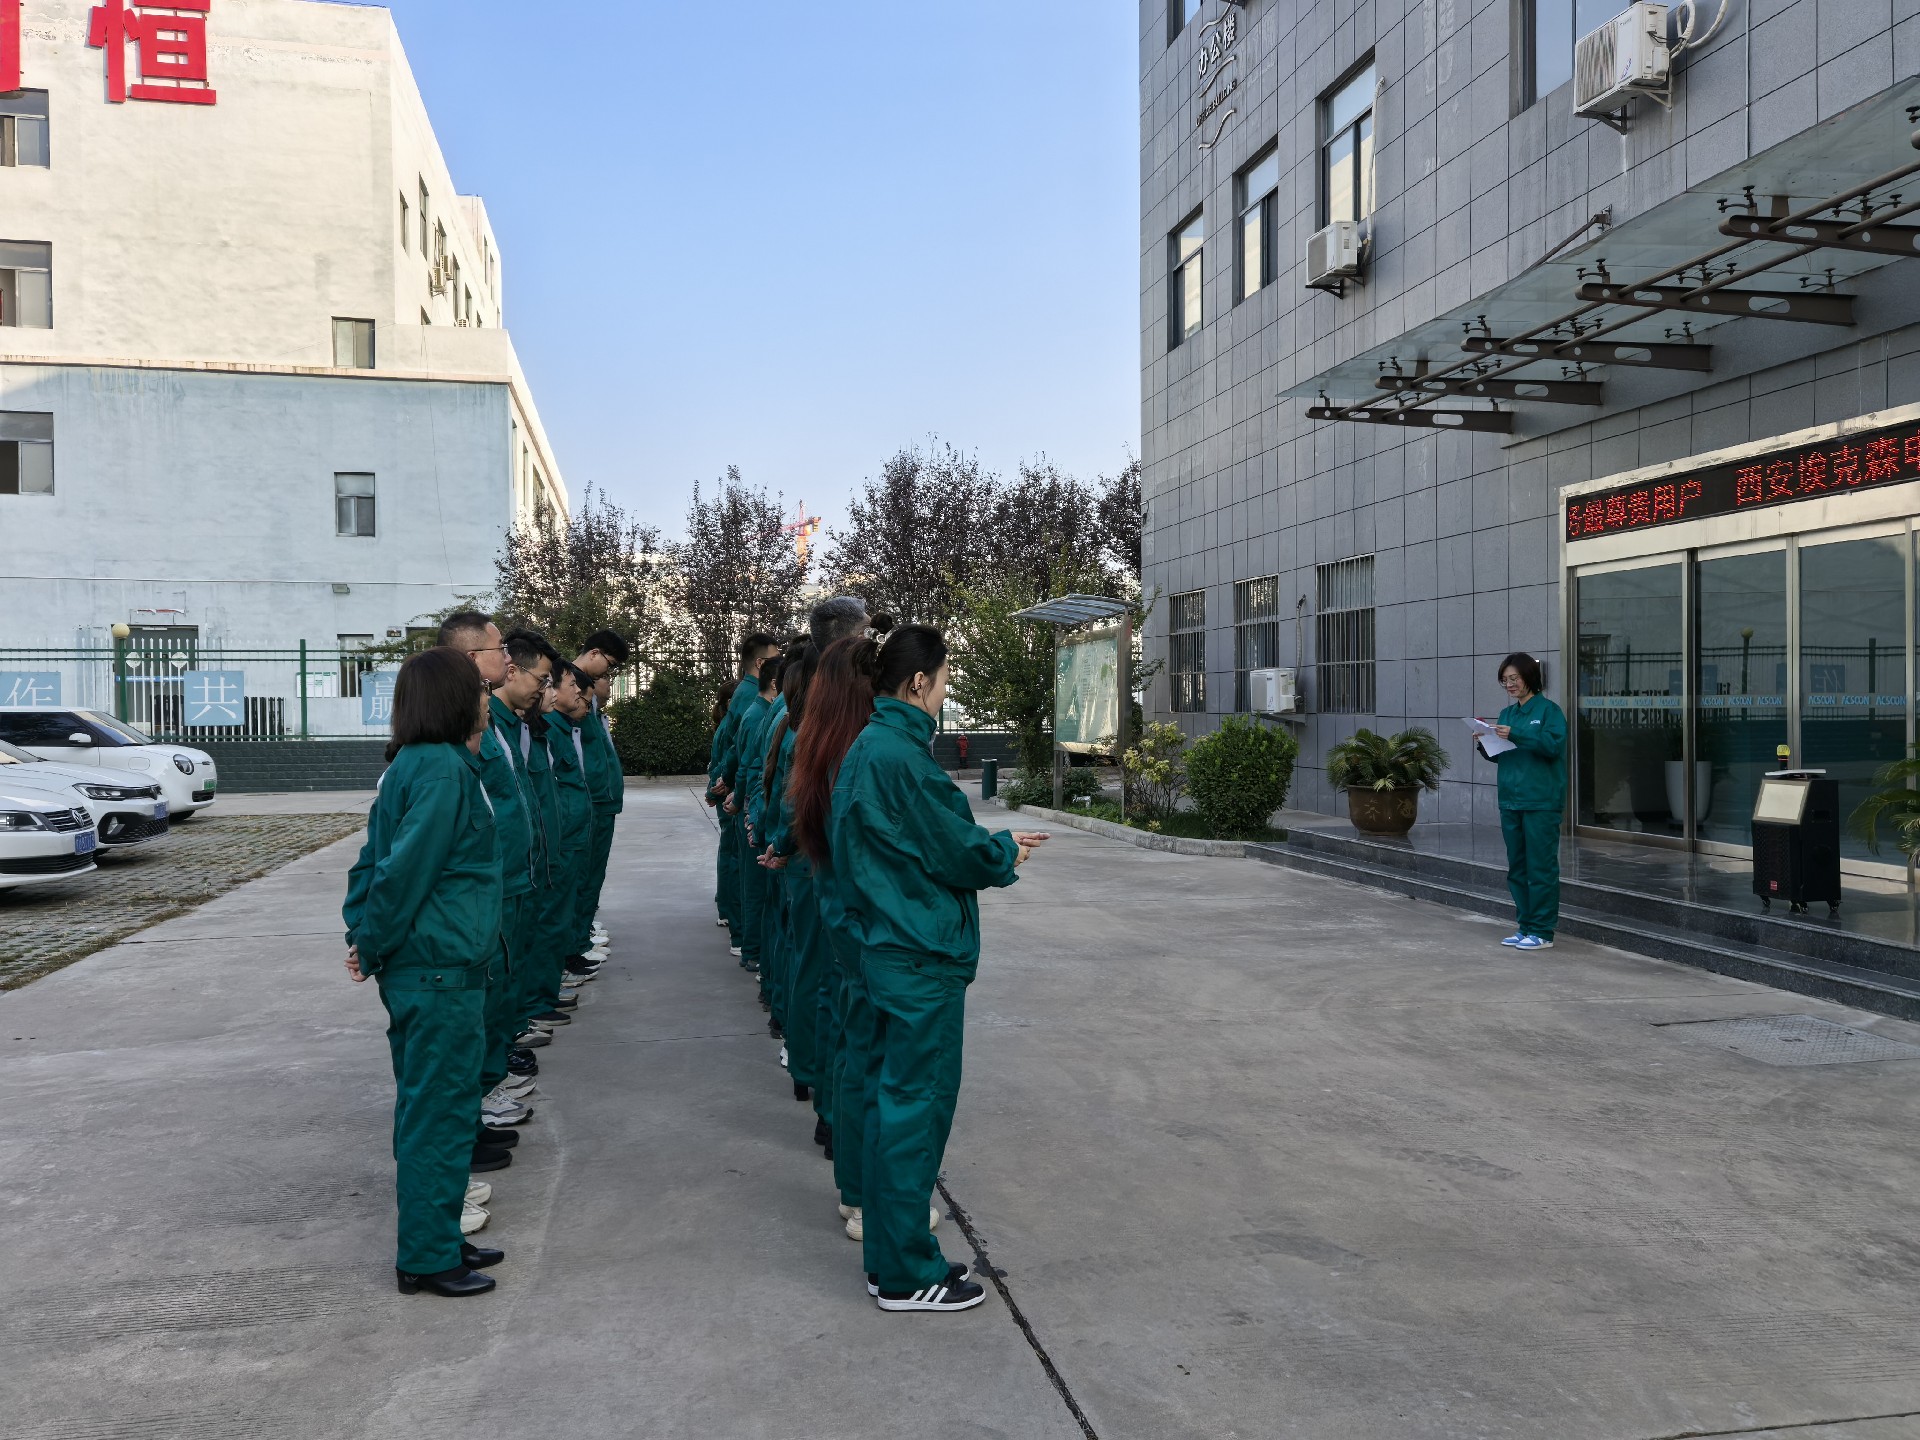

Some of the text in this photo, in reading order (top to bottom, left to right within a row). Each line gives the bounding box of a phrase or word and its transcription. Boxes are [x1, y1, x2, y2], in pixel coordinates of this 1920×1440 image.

[89, 0, 216, 104] 恒
[1199, 13, 1236, 80] 办公楼
[5, 677, 54, 706] 作
[191, 676, 239, 721] 共
